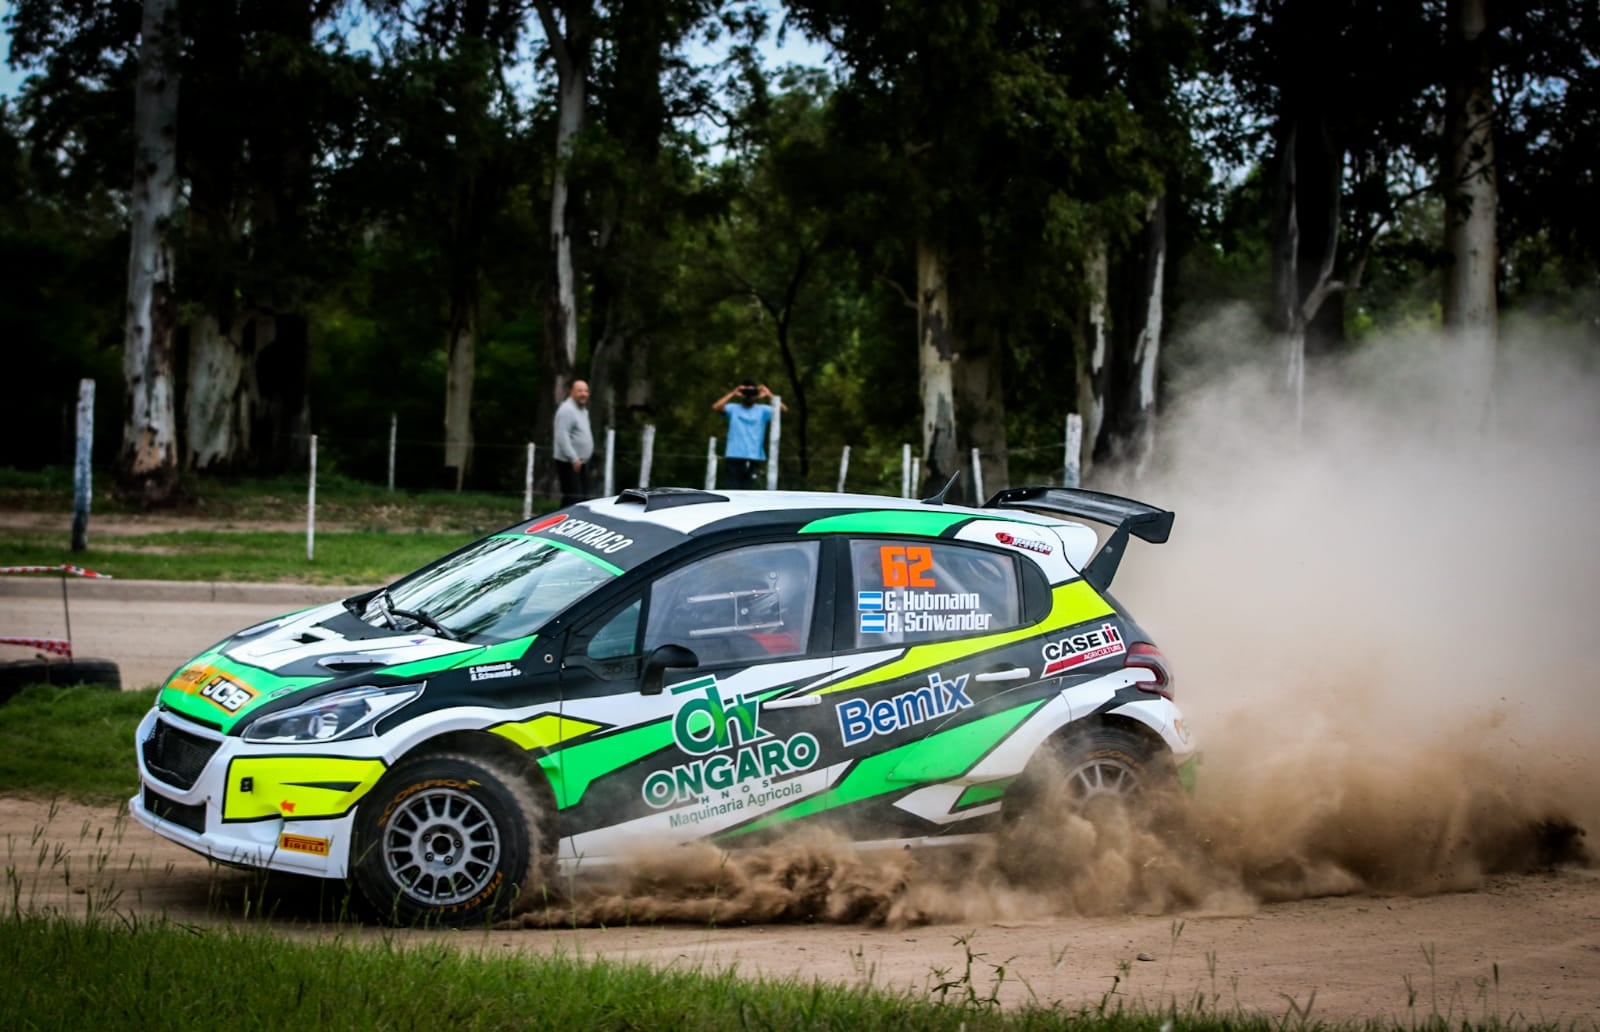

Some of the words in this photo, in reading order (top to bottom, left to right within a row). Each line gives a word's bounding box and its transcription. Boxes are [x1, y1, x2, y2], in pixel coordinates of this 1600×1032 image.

[549, 518, 634, 554] SENTRACO
[880, 546, 936, 588] 62
[1044, 633, 1102, 660] CASE
[1083, 643, 1122, 661] AGRICULTURE
[202, 679, 251, 711] JCB
[837, 673, 973, 746] Bemix
[643, 734, 819, 807] ONGARO
[669, 798, 745, 828] Maquinaria
[284, 838, 325, 853] PIRELLI
